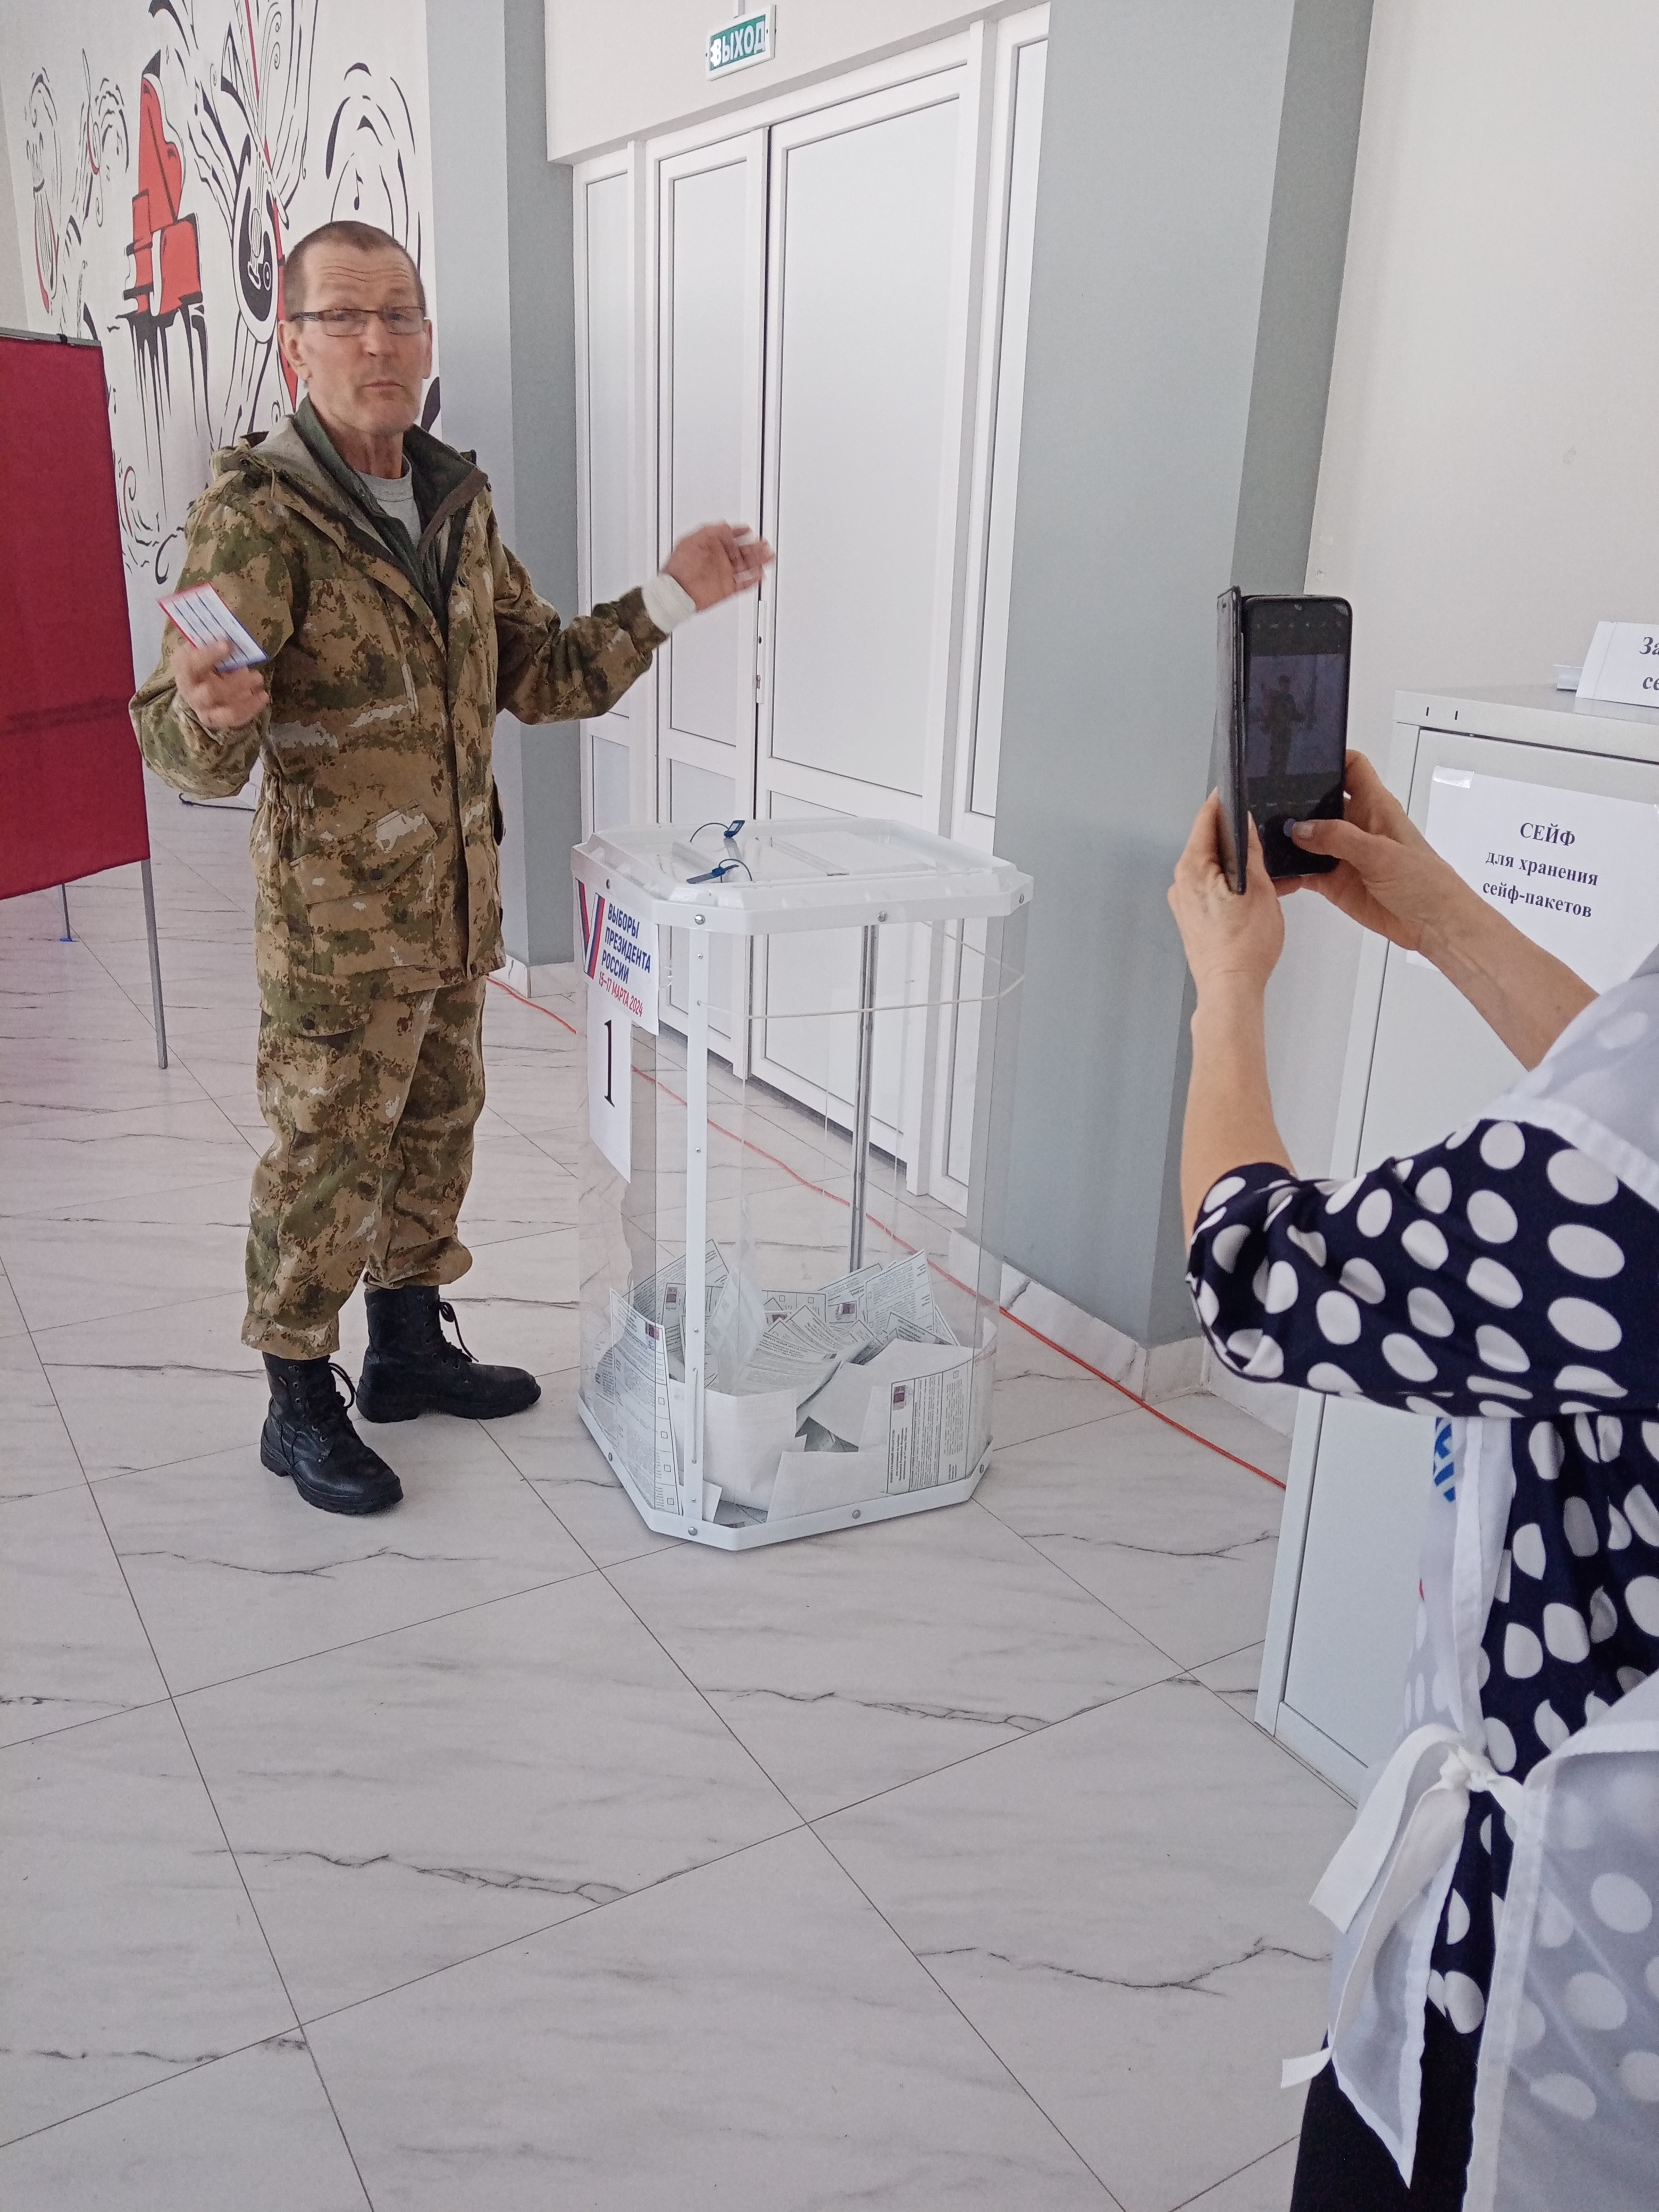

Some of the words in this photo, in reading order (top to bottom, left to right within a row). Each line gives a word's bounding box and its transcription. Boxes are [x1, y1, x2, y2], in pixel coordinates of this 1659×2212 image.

[710, 20, 765, 67] ВЫХОД
[1520, 823, 1576, 847] СЕЙФ
[1486, 852, 1514, 868] для
[1519, 858, 1599, 886] хранения
[1482, 882, 1592, 918] сейф-пакетов
[607, 902, 640, 939] ВЫБОРЫ
[601, 949, 630, 984] РОССИИ
[604, 926, 651, 974] ПРЕЗИДЕНТА
[611, 982, 630, 1008] МАРТА
[629, 995, 643, 1017] 2024
[604, 1019, 615, 1108] 1
